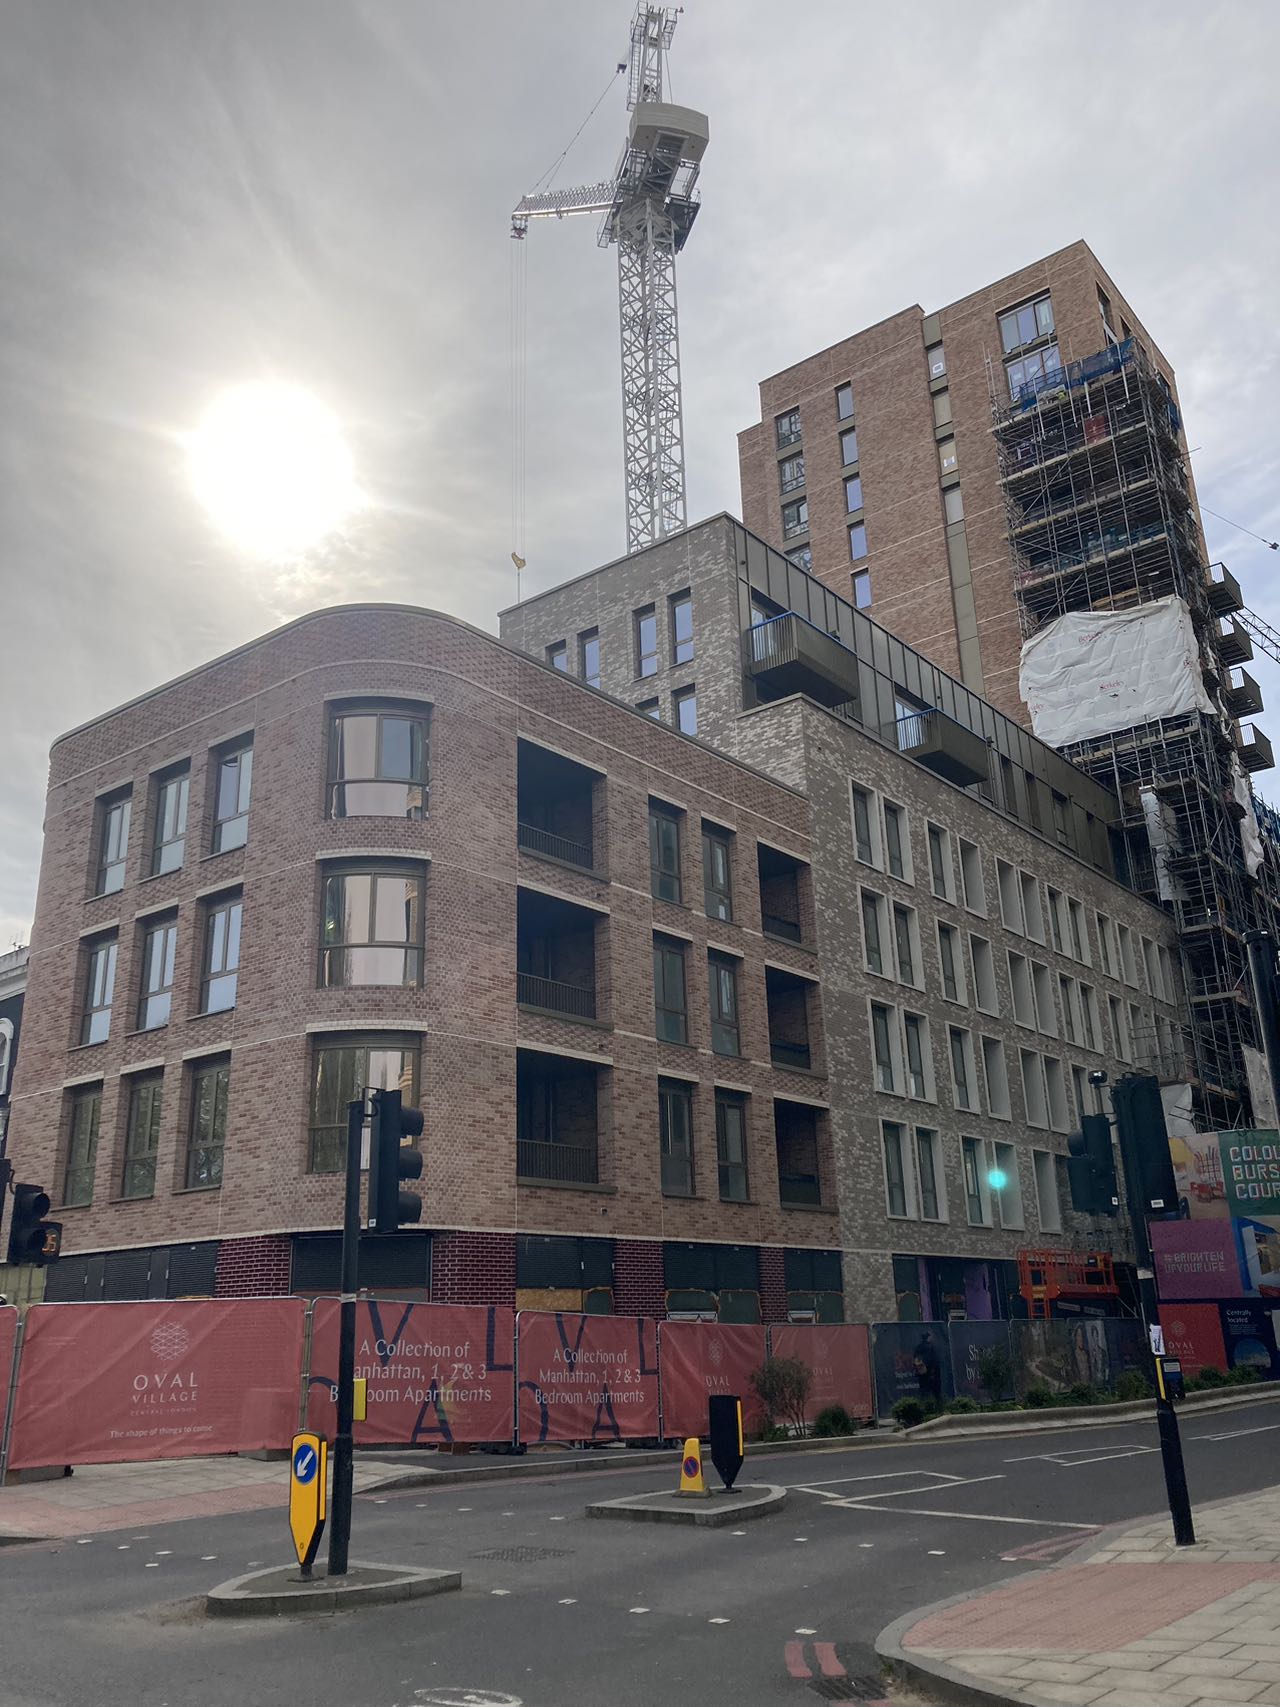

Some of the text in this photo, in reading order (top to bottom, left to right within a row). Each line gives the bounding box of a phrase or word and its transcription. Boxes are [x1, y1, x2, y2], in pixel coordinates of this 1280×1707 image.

[359, 1339, 470, 1358] A Collection of
[553, 1348, 629, 1364] A Collection of
[354, 1362, 426, 1382] anhattan,
[462, 1363, 474, 1379] &
[478, 1363, 487, 1380] 3
[539, 1368, 600, 1385] Manhattan,
[615, 1369, 622, 1383] 2
[623, 1369, 633, 1383] &
[635, 1369, 642, 1383] 3
[133, 1372, 198, 1391] OVAL
[705, 1375, 731, 1387] OVAL
[132, 1391, 198, 1404] VILLAGE
[330, 1385, 400, 1403] Boom
[403, 1386, 492, 1406] Apartments
[535, 1388, 645, 1406] Bedroom Apartments
[110, 1429, 125, 1439] The
